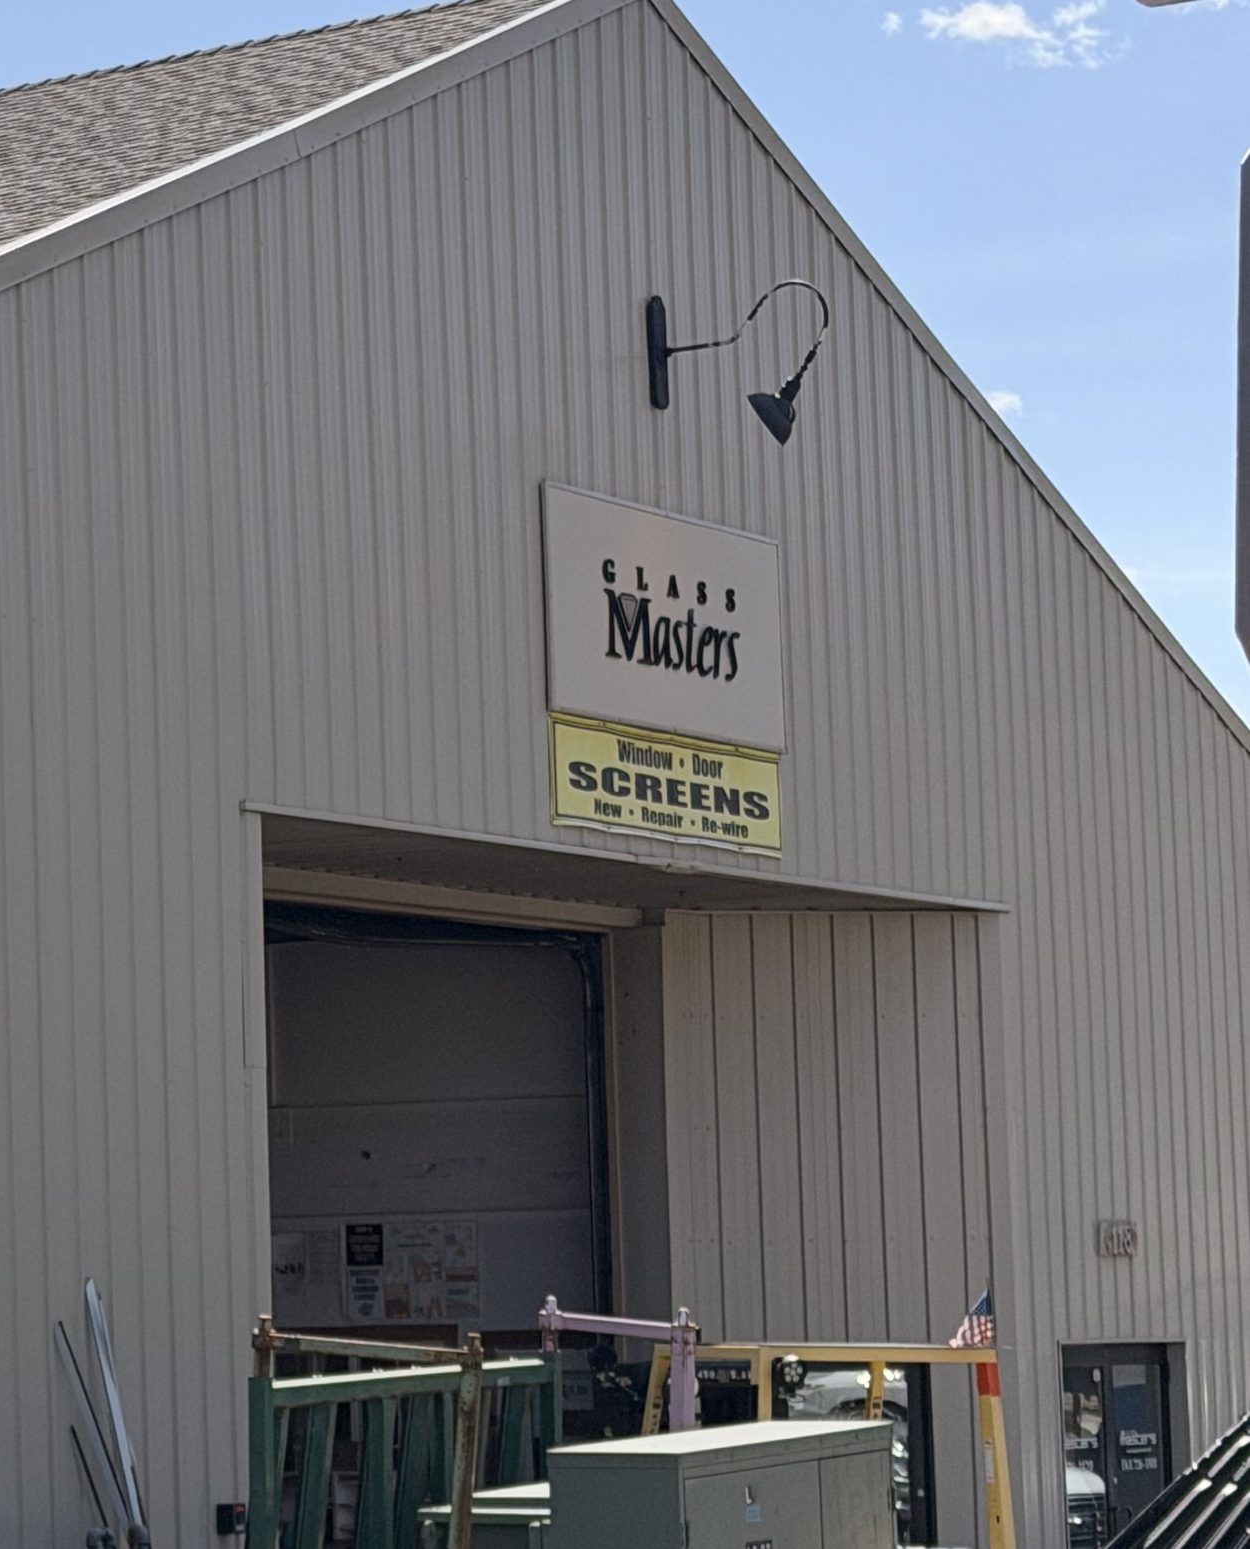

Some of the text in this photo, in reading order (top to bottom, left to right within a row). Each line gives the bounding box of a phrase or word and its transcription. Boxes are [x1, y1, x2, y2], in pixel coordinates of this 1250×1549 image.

[602, 558, 736, 613] GLASS
[603, 588, 740, 682] Masters
[616, 738, 724, 779] Window Door
[568, 761, 770, 820] SCREENS
[594, 798, 749, 838] New Repair Re-wire
